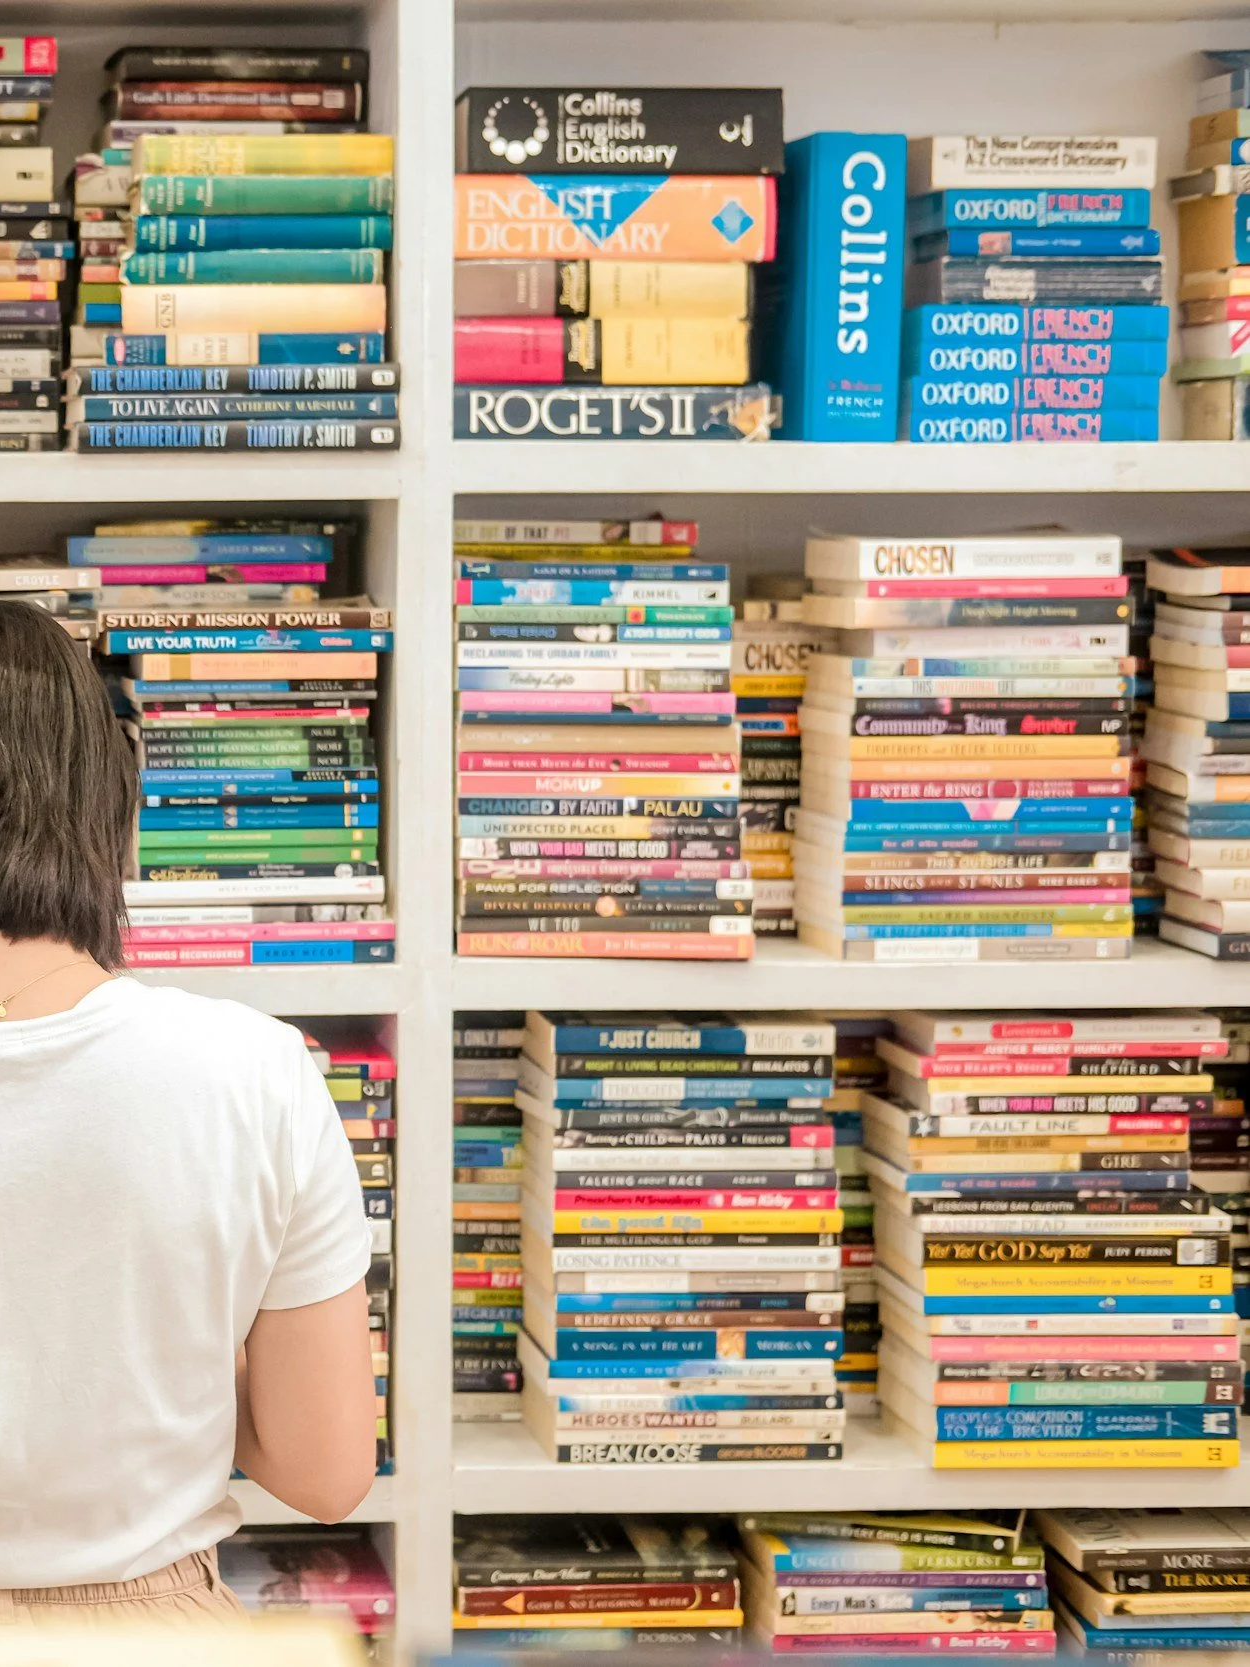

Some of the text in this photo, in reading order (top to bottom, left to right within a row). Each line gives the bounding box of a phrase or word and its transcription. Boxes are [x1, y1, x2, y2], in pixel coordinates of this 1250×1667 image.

[565, 93, 677, 168] Collins English Dictionary
[965, 136, 1118, 150] The New Comprehensive
[966, 151, 1126, 168] A-Z Crossword Dictionary
[954, 195, 1122, 220] OXFORD FRENCH
[468, 191, 669, 252] ENGLISH DICTIONARY
[837, 151, 887, 354] Collins
[932, 313, 1019, 336] OXFORD
[930, 348, 1016, 371] OXFORD
[91, 369, 228, 390] THE CHAMBERLAIN KEY
[248, 369, 356, 389] TIMOTHY P. SMITH
[922, 383, 1009, 405] OXFORD
[110, 399, 220, 414] TO LIVE AGAIN
[469, 393, 696, 435] ROGET'S II
[919, 419, 1007, 441] OXFORD
[875, 545, 954, 575] CHOSEN
[106, 612, 341, 628] STUDENT MISSION POWER
[127, 637, 235, 649] LIVE YOUR TRUTH
[469, 801, 617, 815] CHANGED BY FAITH
[644, 802, 703, 816] PALAU
[483, 823, 615, 834] UNEXPECTED PLACES
[609, 1030, 700, 1049] JUST CHURCH
[970, 1119, 1078, 1132] FAULT LINE
[978, 1242, 1037, 1262] GOD
[573, 1414, 716, 1426] HEROES WANTED
[570, 1445, 701, 1463] BREAK LOOSE
[1162, 1554, 1213, 1569] MORE
